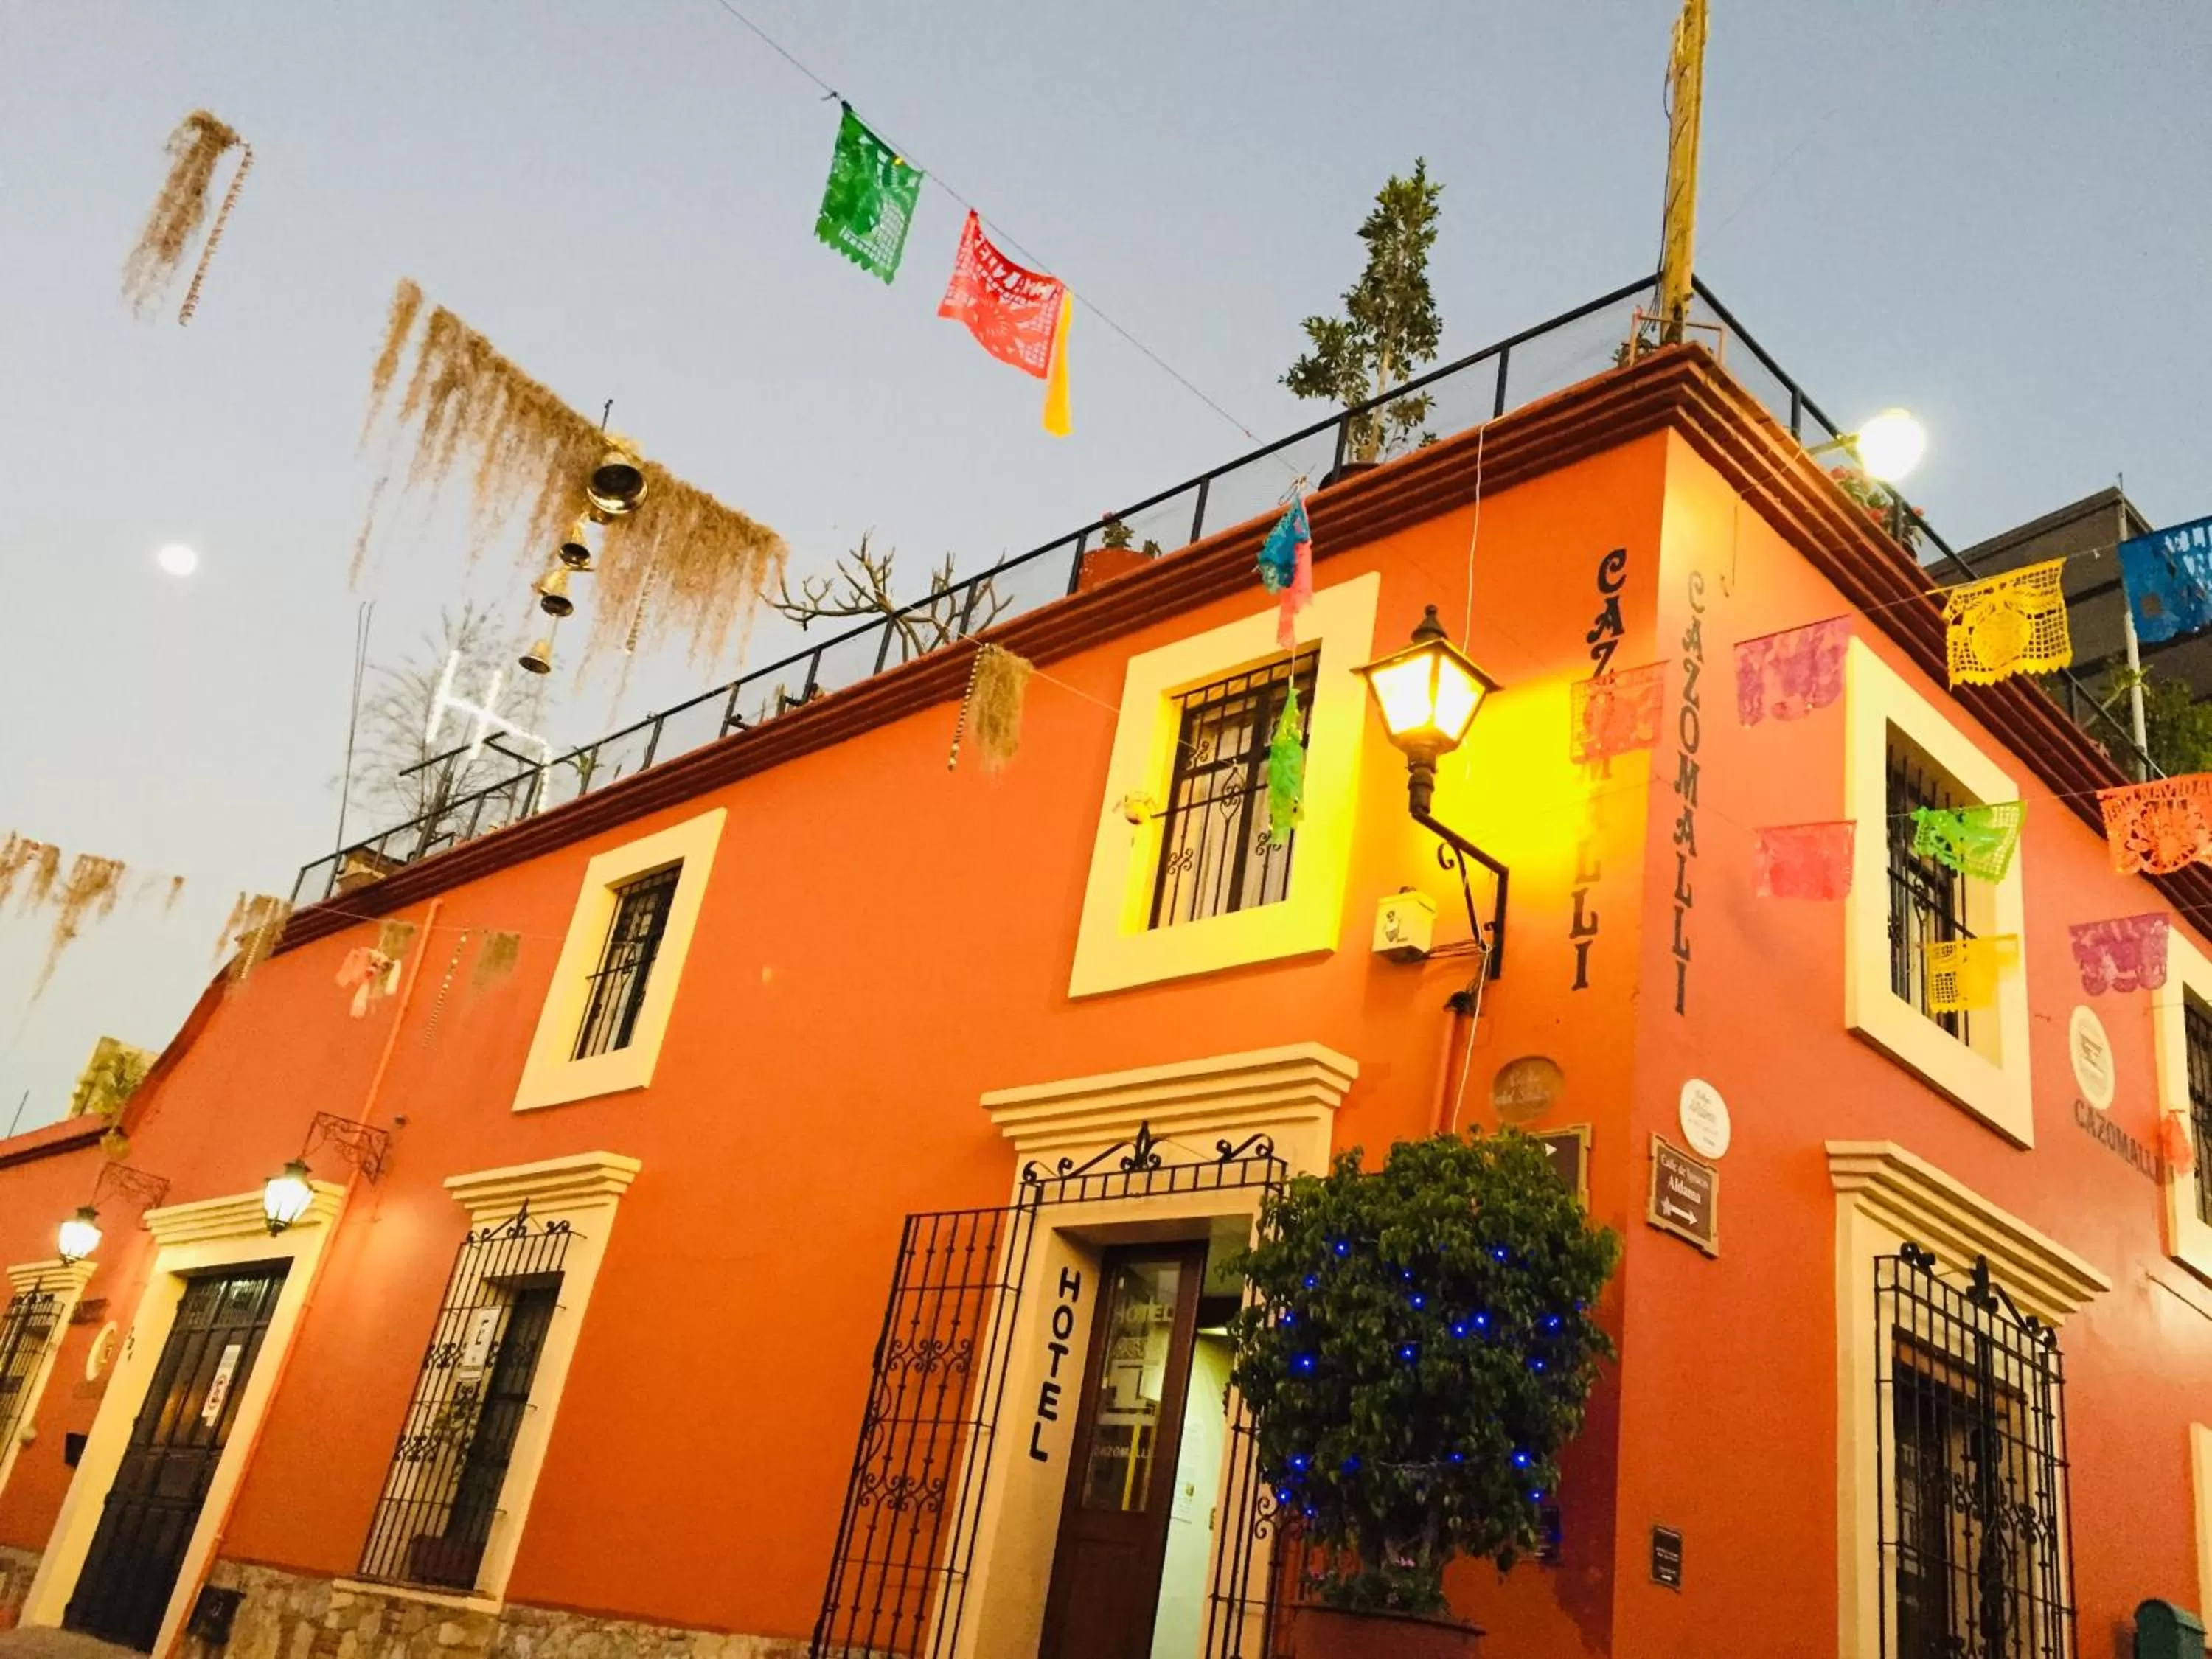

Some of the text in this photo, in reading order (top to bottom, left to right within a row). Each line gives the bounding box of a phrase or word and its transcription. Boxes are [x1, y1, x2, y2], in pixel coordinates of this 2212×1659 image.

[1673, 571, 1704, 1015] CAZOMALLI
[1668, 1175, 1701, 1204] Aldama
[1029, 1266, 1081, 1463] HOTEL
